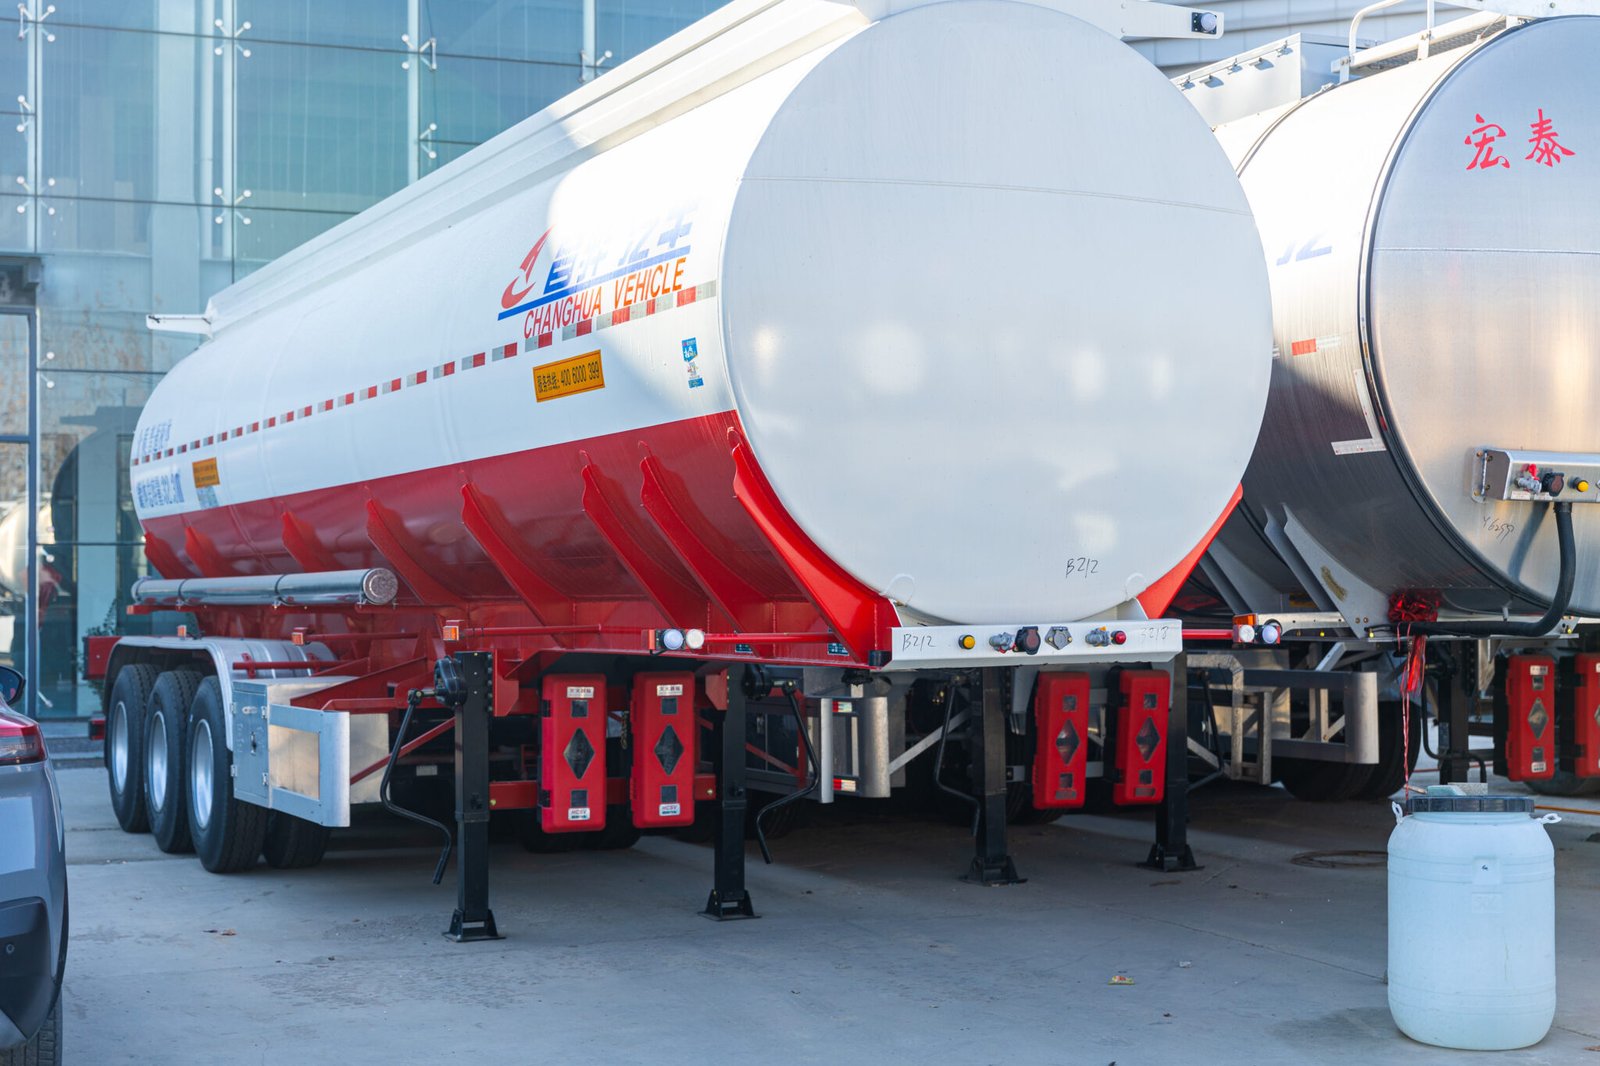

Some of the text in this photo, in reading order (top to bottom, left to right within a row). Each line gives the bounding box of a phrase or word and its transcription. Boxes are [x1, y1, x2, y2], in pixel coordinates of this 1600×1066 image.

[1465, 108, 1576, 170] 宏泰
[524, 257, 687, 339] CHANGHUA VEHICLE
[561, 369, 572, 387] 400
[572, 364, 587, 385] 6000
